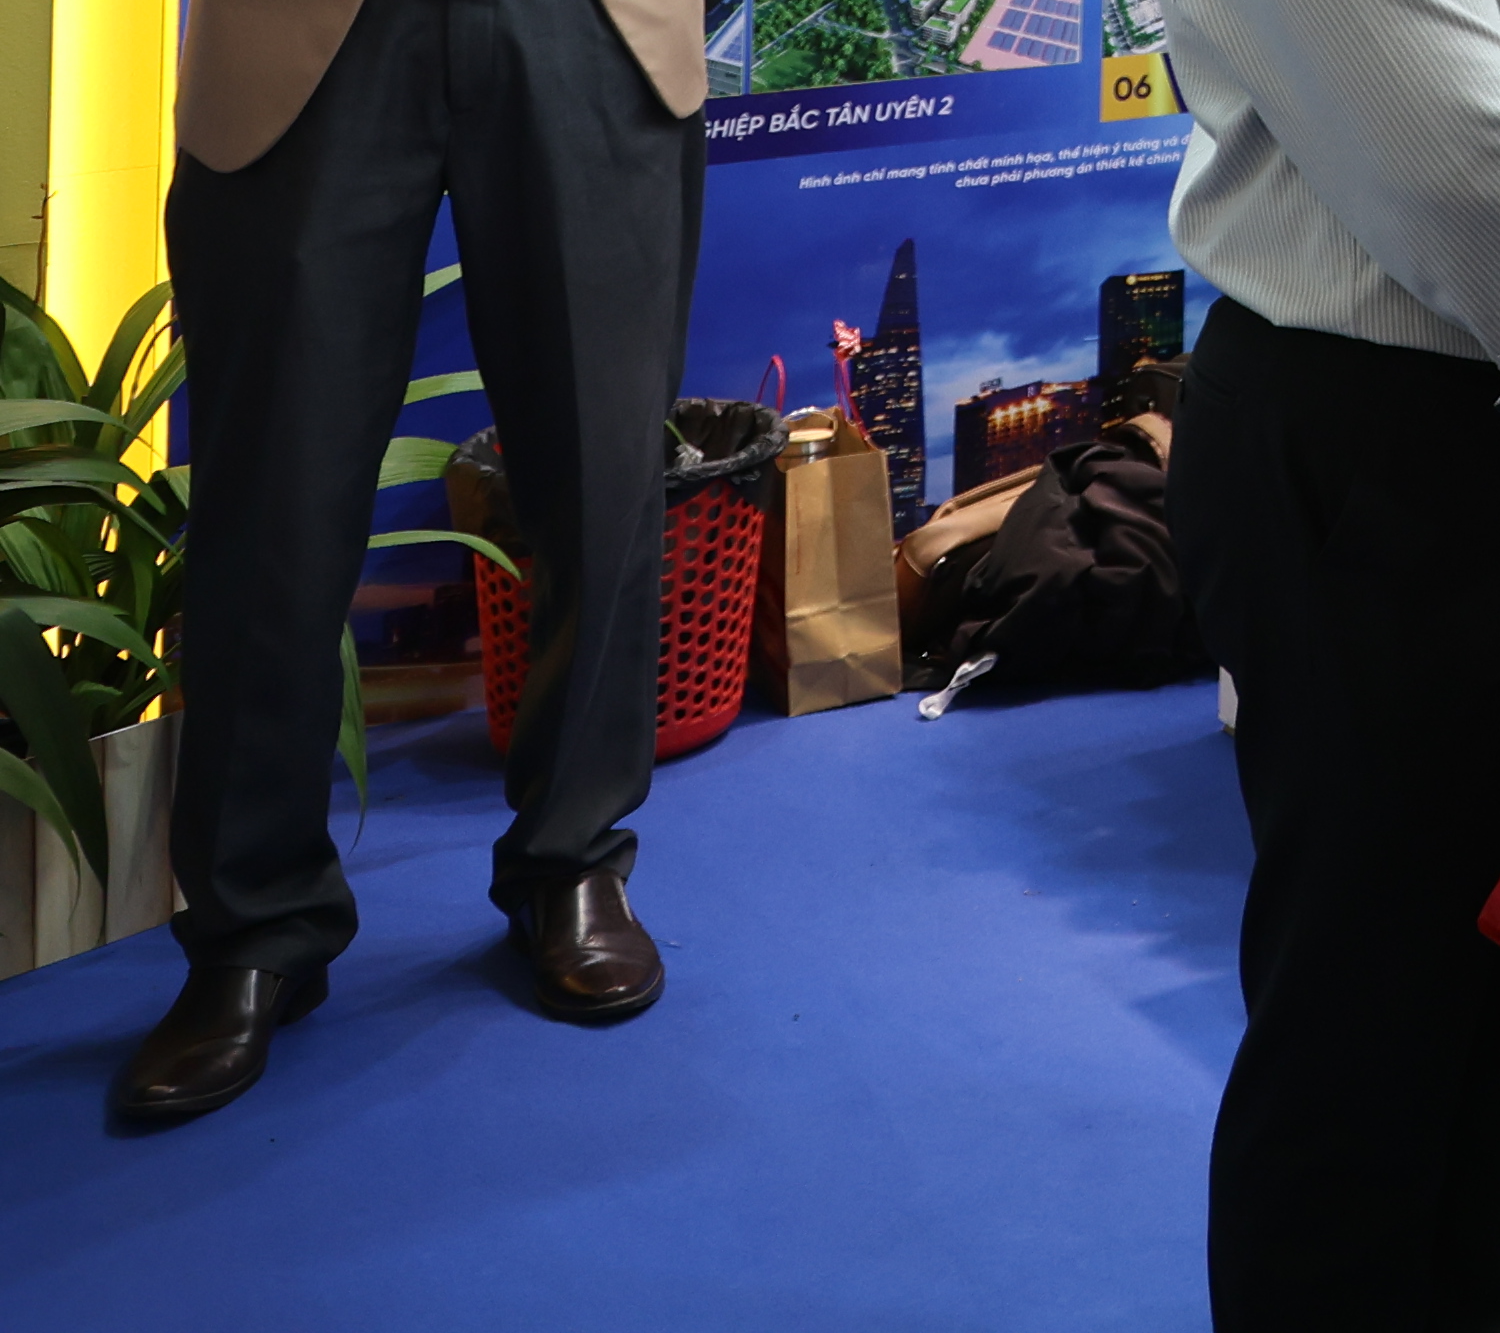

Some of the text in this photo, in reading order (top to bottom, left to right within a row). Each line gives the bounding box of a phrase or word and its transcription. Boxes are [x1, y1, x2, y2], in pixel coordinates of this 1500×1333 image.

[1114, 76, 1152, 101] 06
[769, 97, 818, 133] BẮC
[824, 100, 873, 126] TÂN
[875, 94, 936, 123] UYÊN
[937, 96, 954, 116] 2
